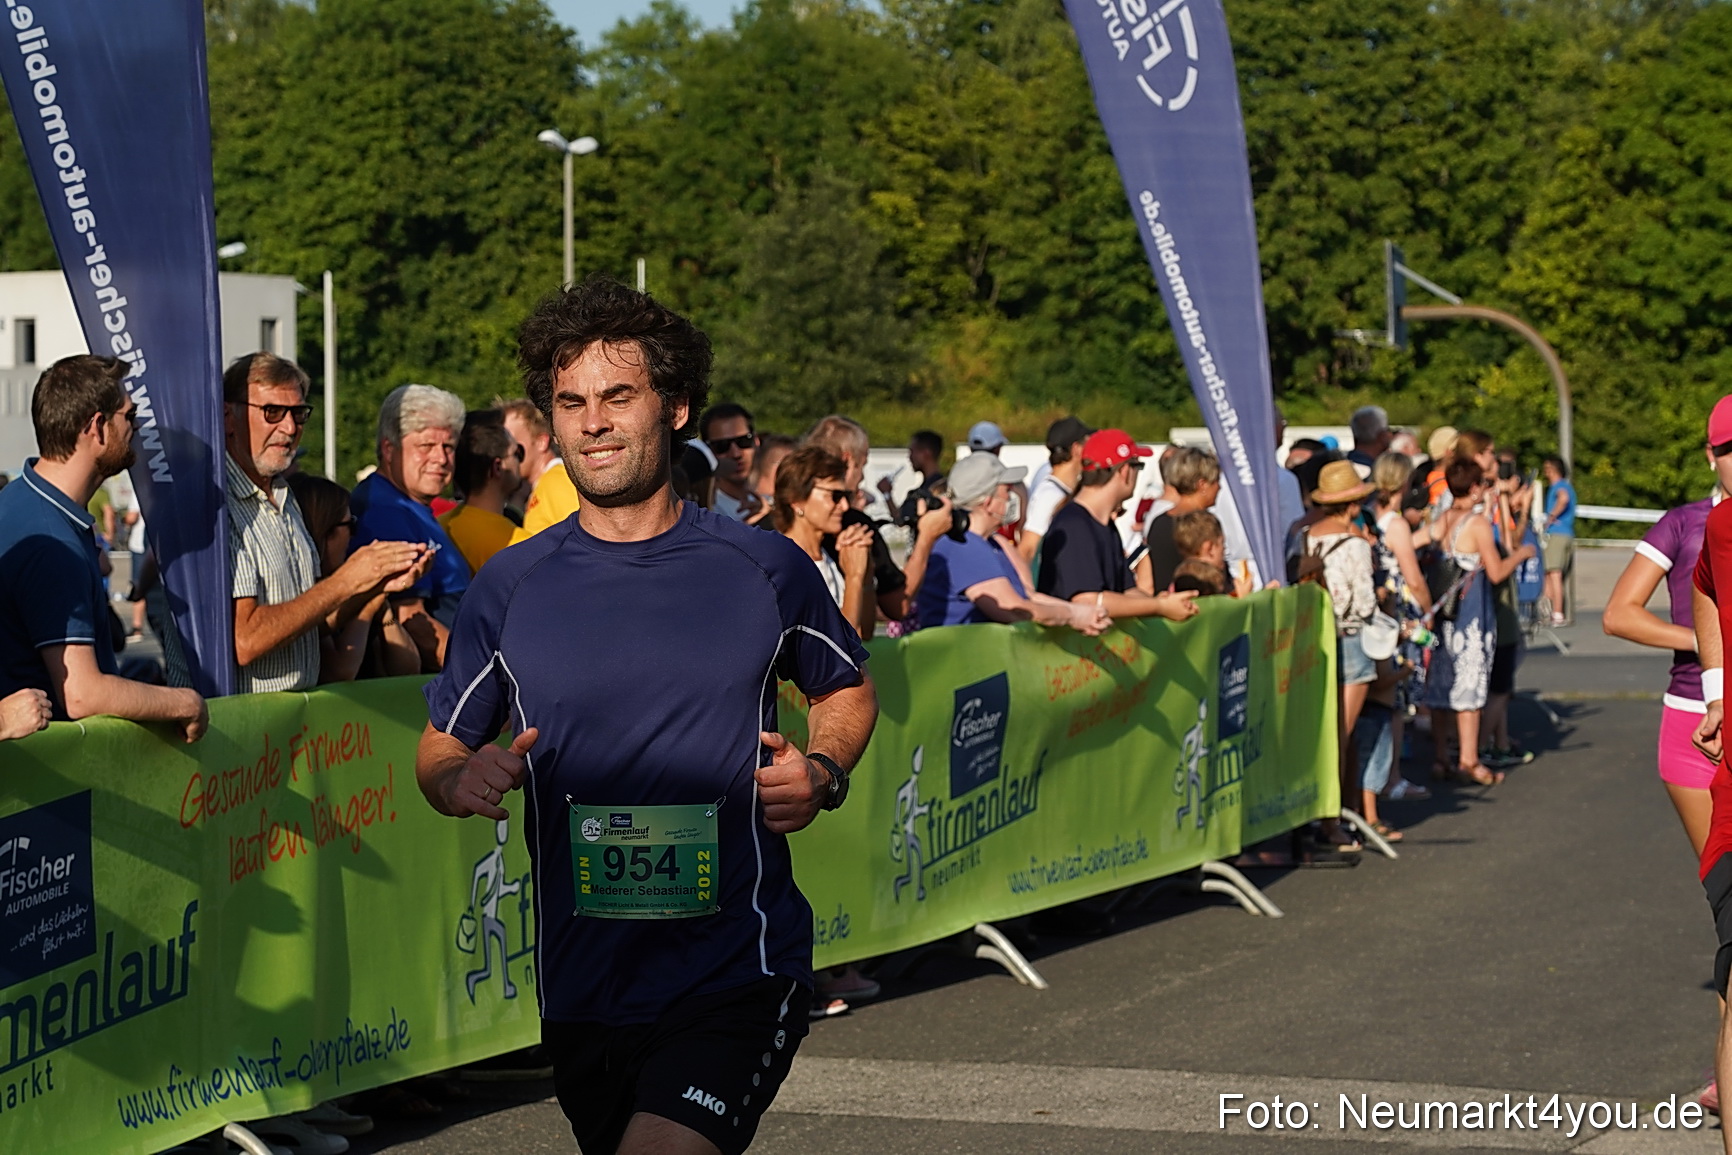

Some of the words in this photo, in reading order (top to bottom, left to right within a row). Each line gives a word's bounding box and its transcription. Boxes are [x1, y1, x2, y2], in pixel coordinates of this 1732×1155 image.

[960, 711, 1002, 740] Fischer
[179, 732, 282, 830] Gesunde
[288, 721, 373, 783] Firmen
[229, 807, 308, 885] laufen
[310, 762, 397, 854] länger!
[927, 748, 1048, 863] firmenlauf
[603, 826, 650, 836] Firmenlauf
[0, 853, 75, 900] Fischer
[579, 856, 592, 894] RUN
[602, 845, 681, 882] 954
[697, 850, 711, 901] 2022
[931, 848, 982, 889] neumarkt
[5, 882, 70, 917] AUTOMOBILE
[590, 884, 635, 896] Mederer
[637, 884, 697, 896] Sebastian
[37, 917, 54, 935] das
[0, 1060, 54, 1113] arkt
[681, 1085, 726, 1116] JAKO
